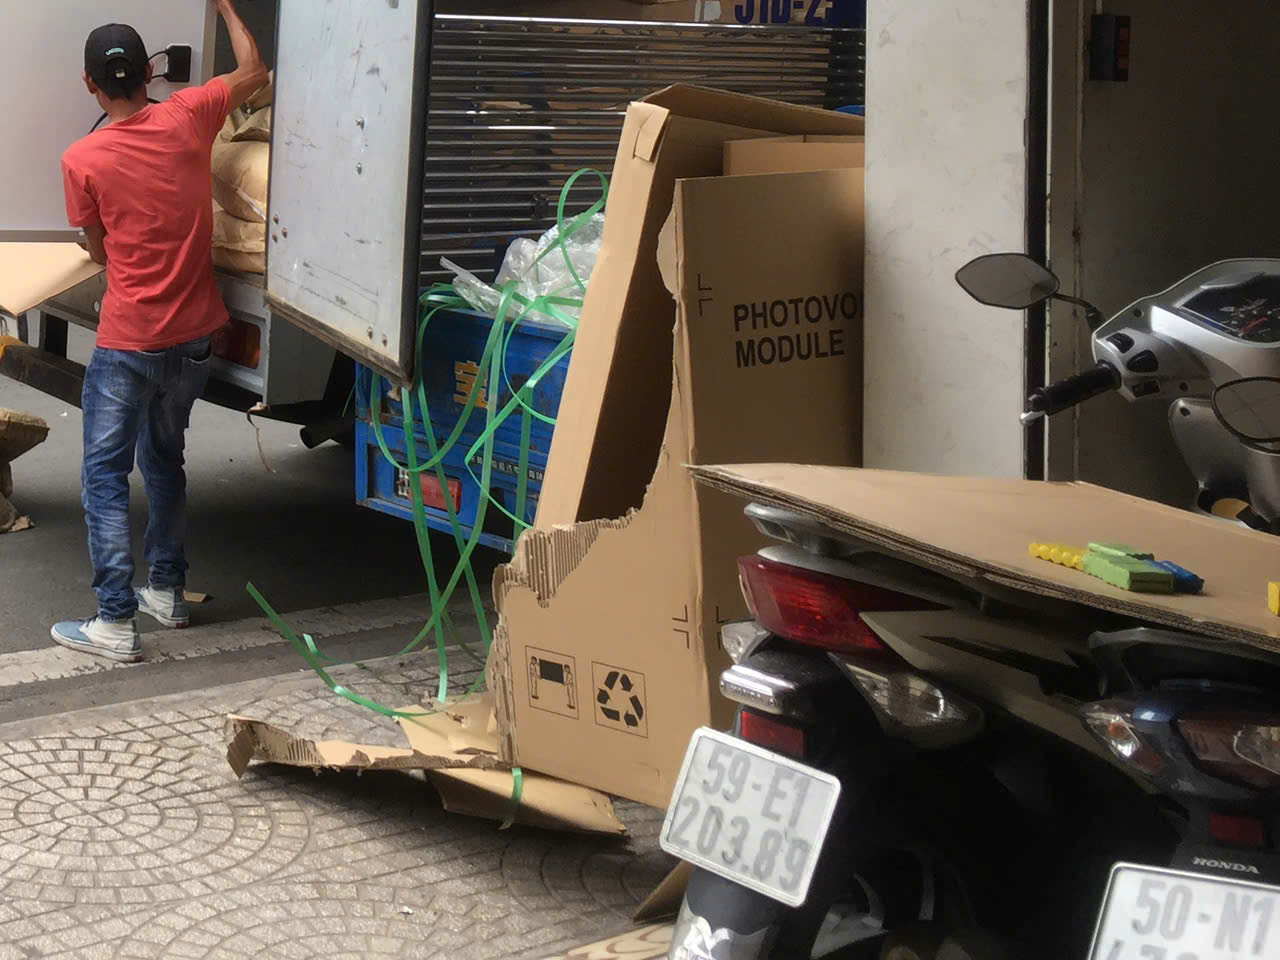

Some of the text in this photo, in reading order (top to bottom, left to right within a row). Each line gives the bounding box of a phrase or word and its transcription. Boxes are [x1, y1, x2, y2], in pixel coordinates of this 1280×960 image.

[733, 291, 863, 332] PHOTOVO
[736, 329, 845, 368] MODULE
[702, 743, 811, 830] 59-E1
[671, 795, 812, 891] 203.89
[1191, 856, 1260, 875] HONDA
[1131, 877, 1275, 956] 50-N1
